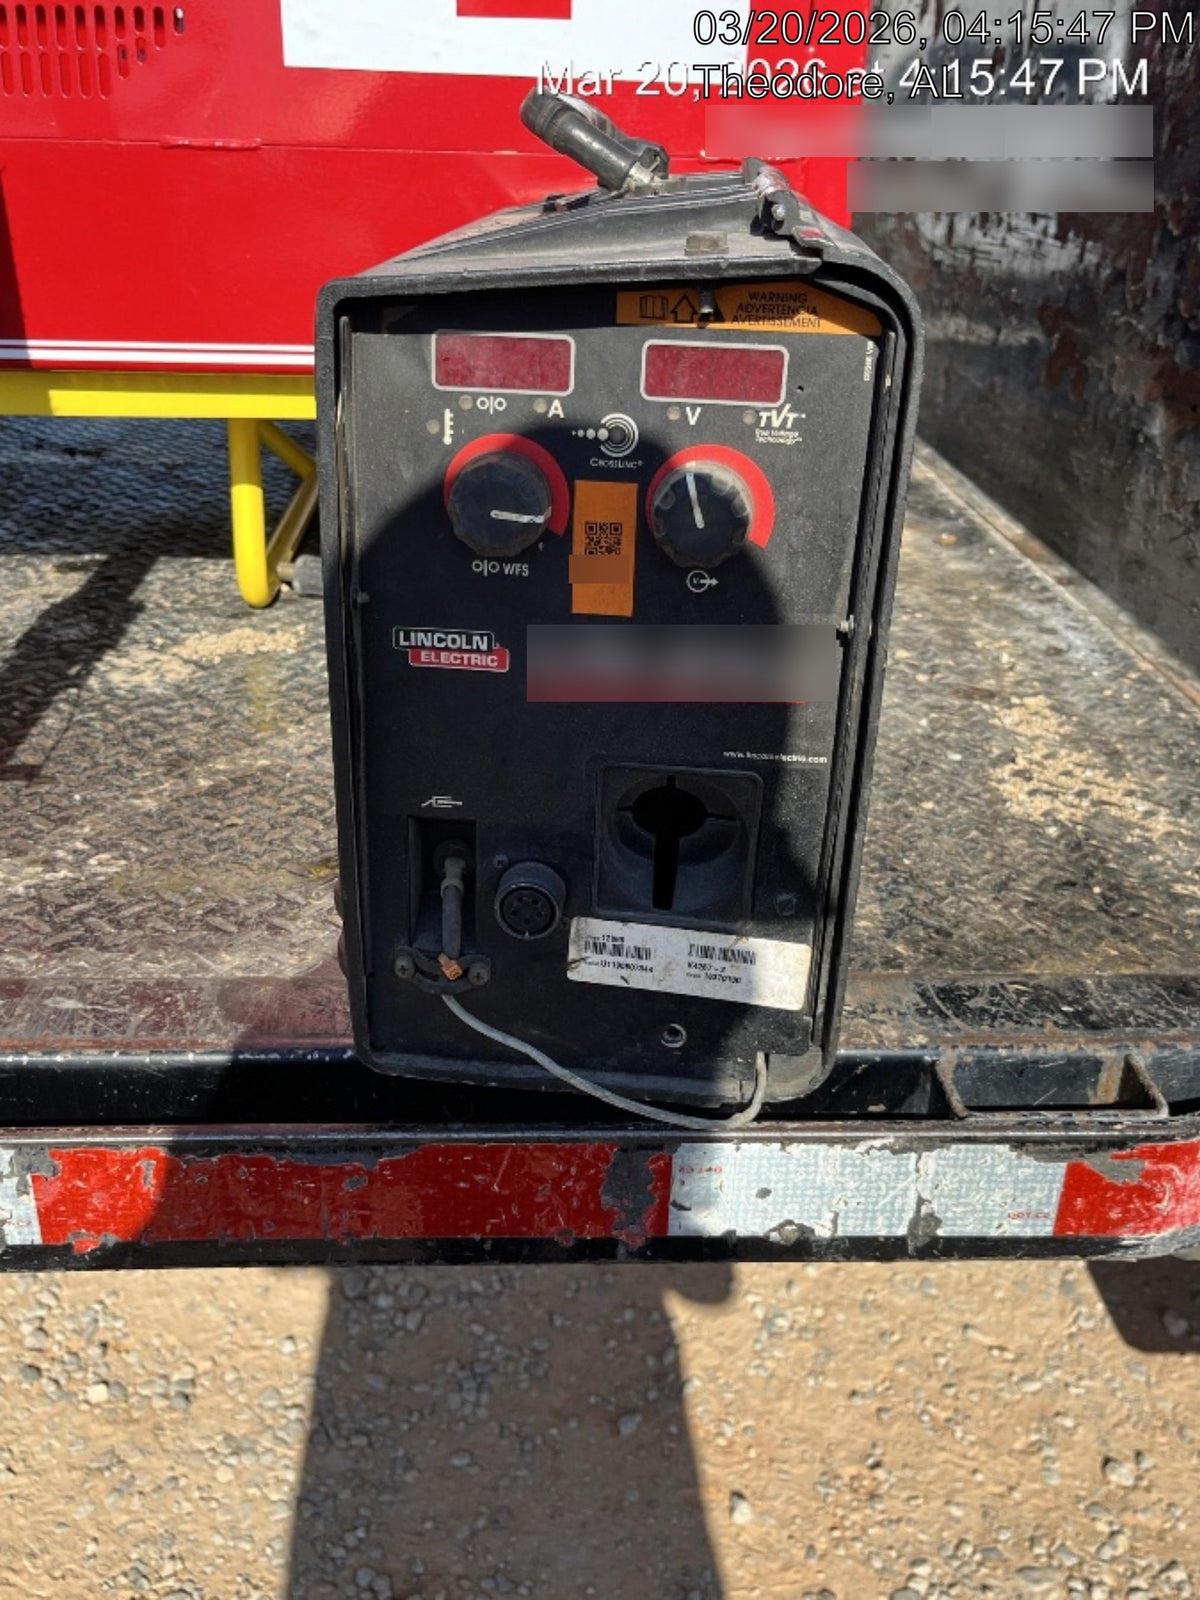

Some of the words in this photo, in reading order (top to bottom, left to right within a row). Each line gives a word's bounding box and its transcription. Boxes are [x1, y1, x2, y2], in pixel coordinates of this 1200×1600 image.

[748, 290, 808, 304] WARNING
[735, 303, 819, 316] ADVERTENCIA
[731, 314, 822, 328] AVERTISSEMENT
[547, 399, 565, 418] A
[685, 406, 701, 426] V
[502, 562, 529, 577] WFS
[399, 630, 489, 652] LINCOLN
[420, 650, 499, 668] ELECTRIC
